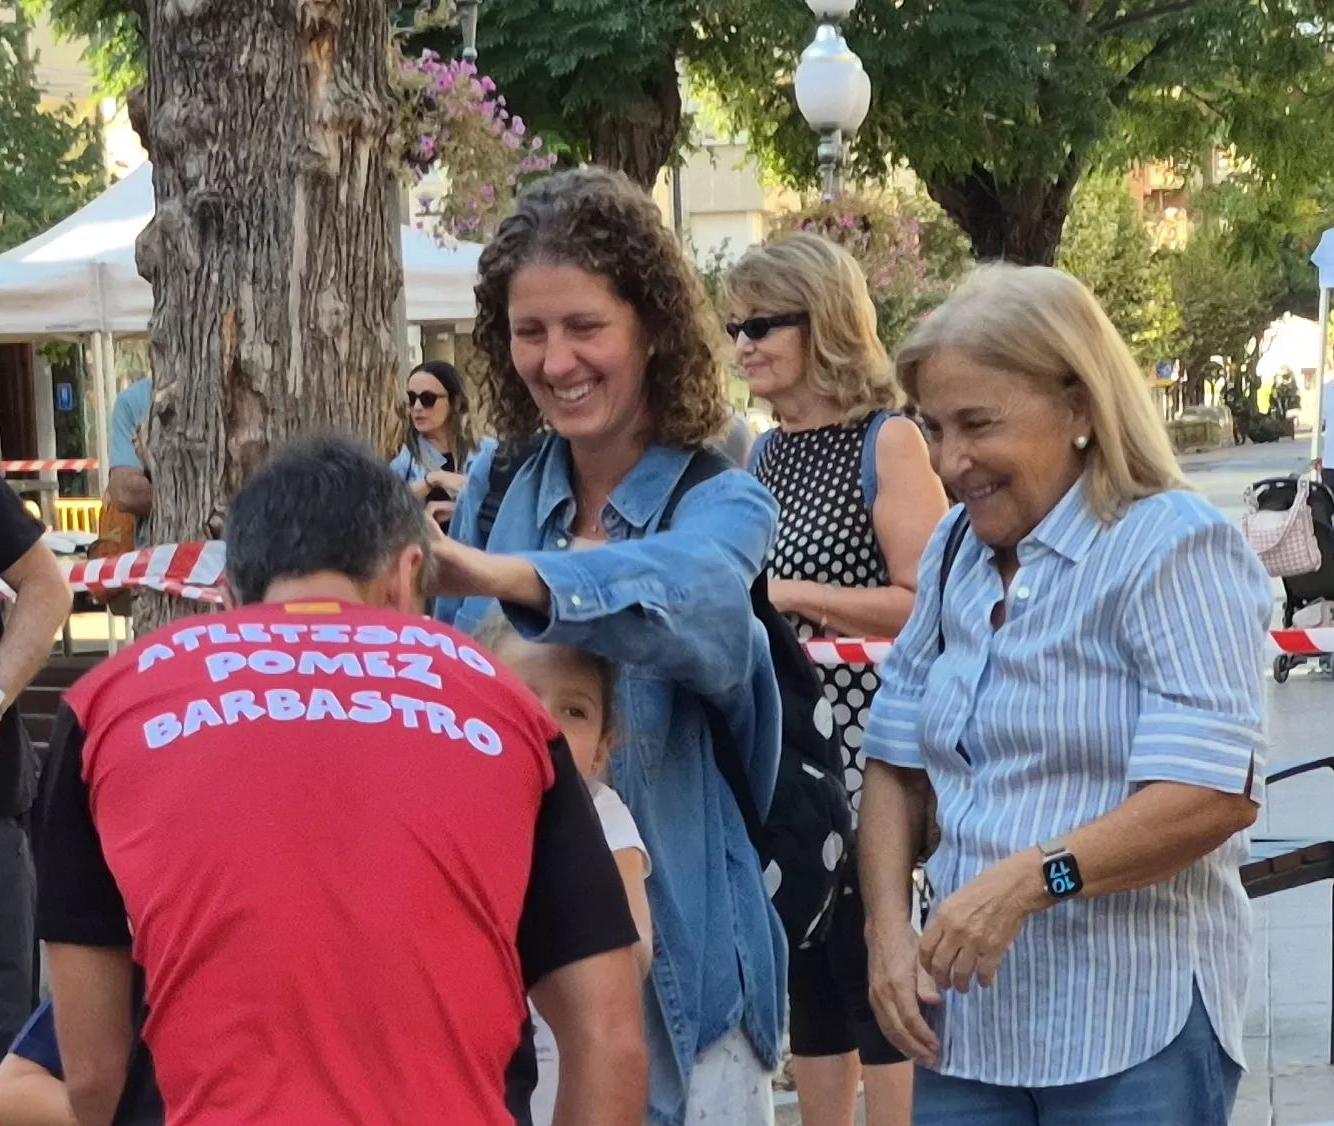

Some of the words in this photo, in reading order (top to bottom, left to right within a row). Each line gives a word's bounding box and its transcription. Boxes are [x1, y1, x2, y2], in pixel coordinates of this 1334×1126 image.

[138, 622, 497, 677] ATLETISMO
[205, 650, 443, 689] POMEZ
[143, 688, 503, 756] BARBASTRO
